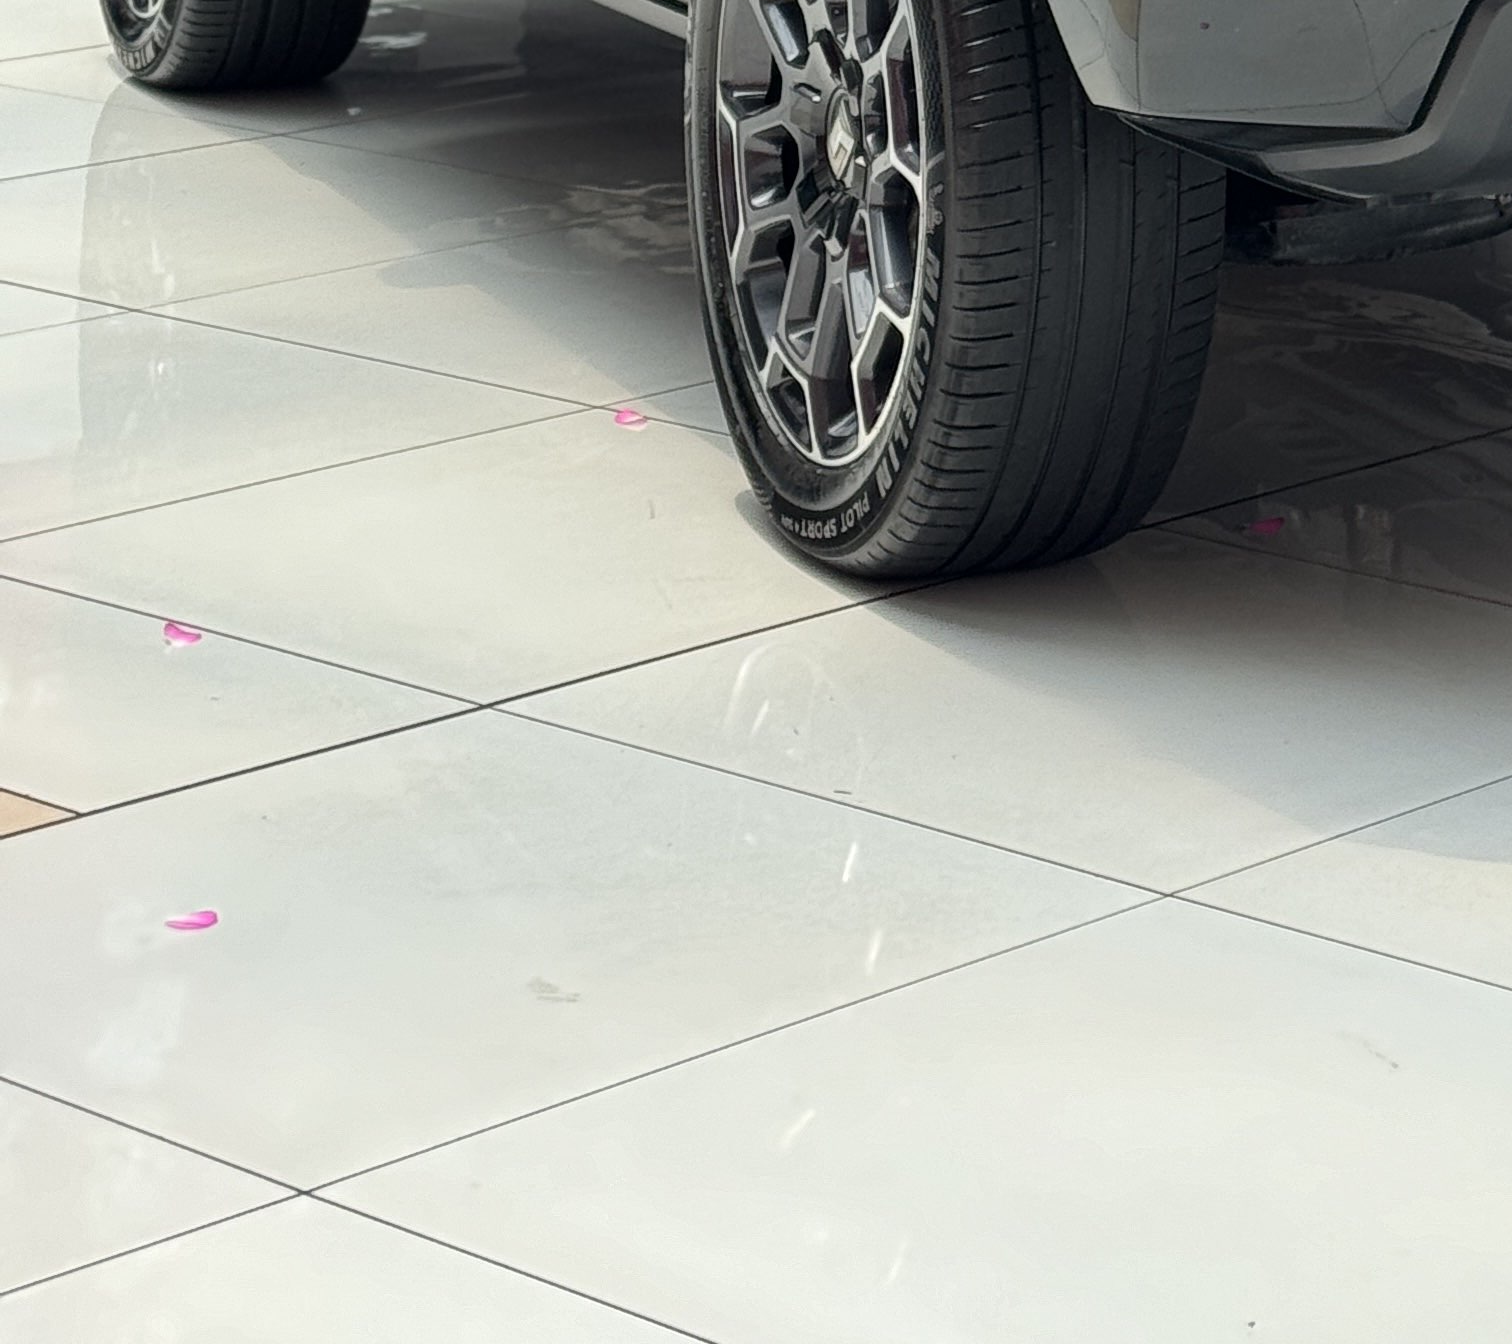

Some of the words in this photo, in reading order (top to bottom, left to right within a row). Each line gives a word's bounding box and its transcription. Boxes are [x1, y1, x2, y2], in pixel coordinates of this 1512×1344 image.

[876, 245, 941, 499] MICHELIN
[800, 517, 837, 539] SPORT
[840, 491, 871, 533] PILOT
